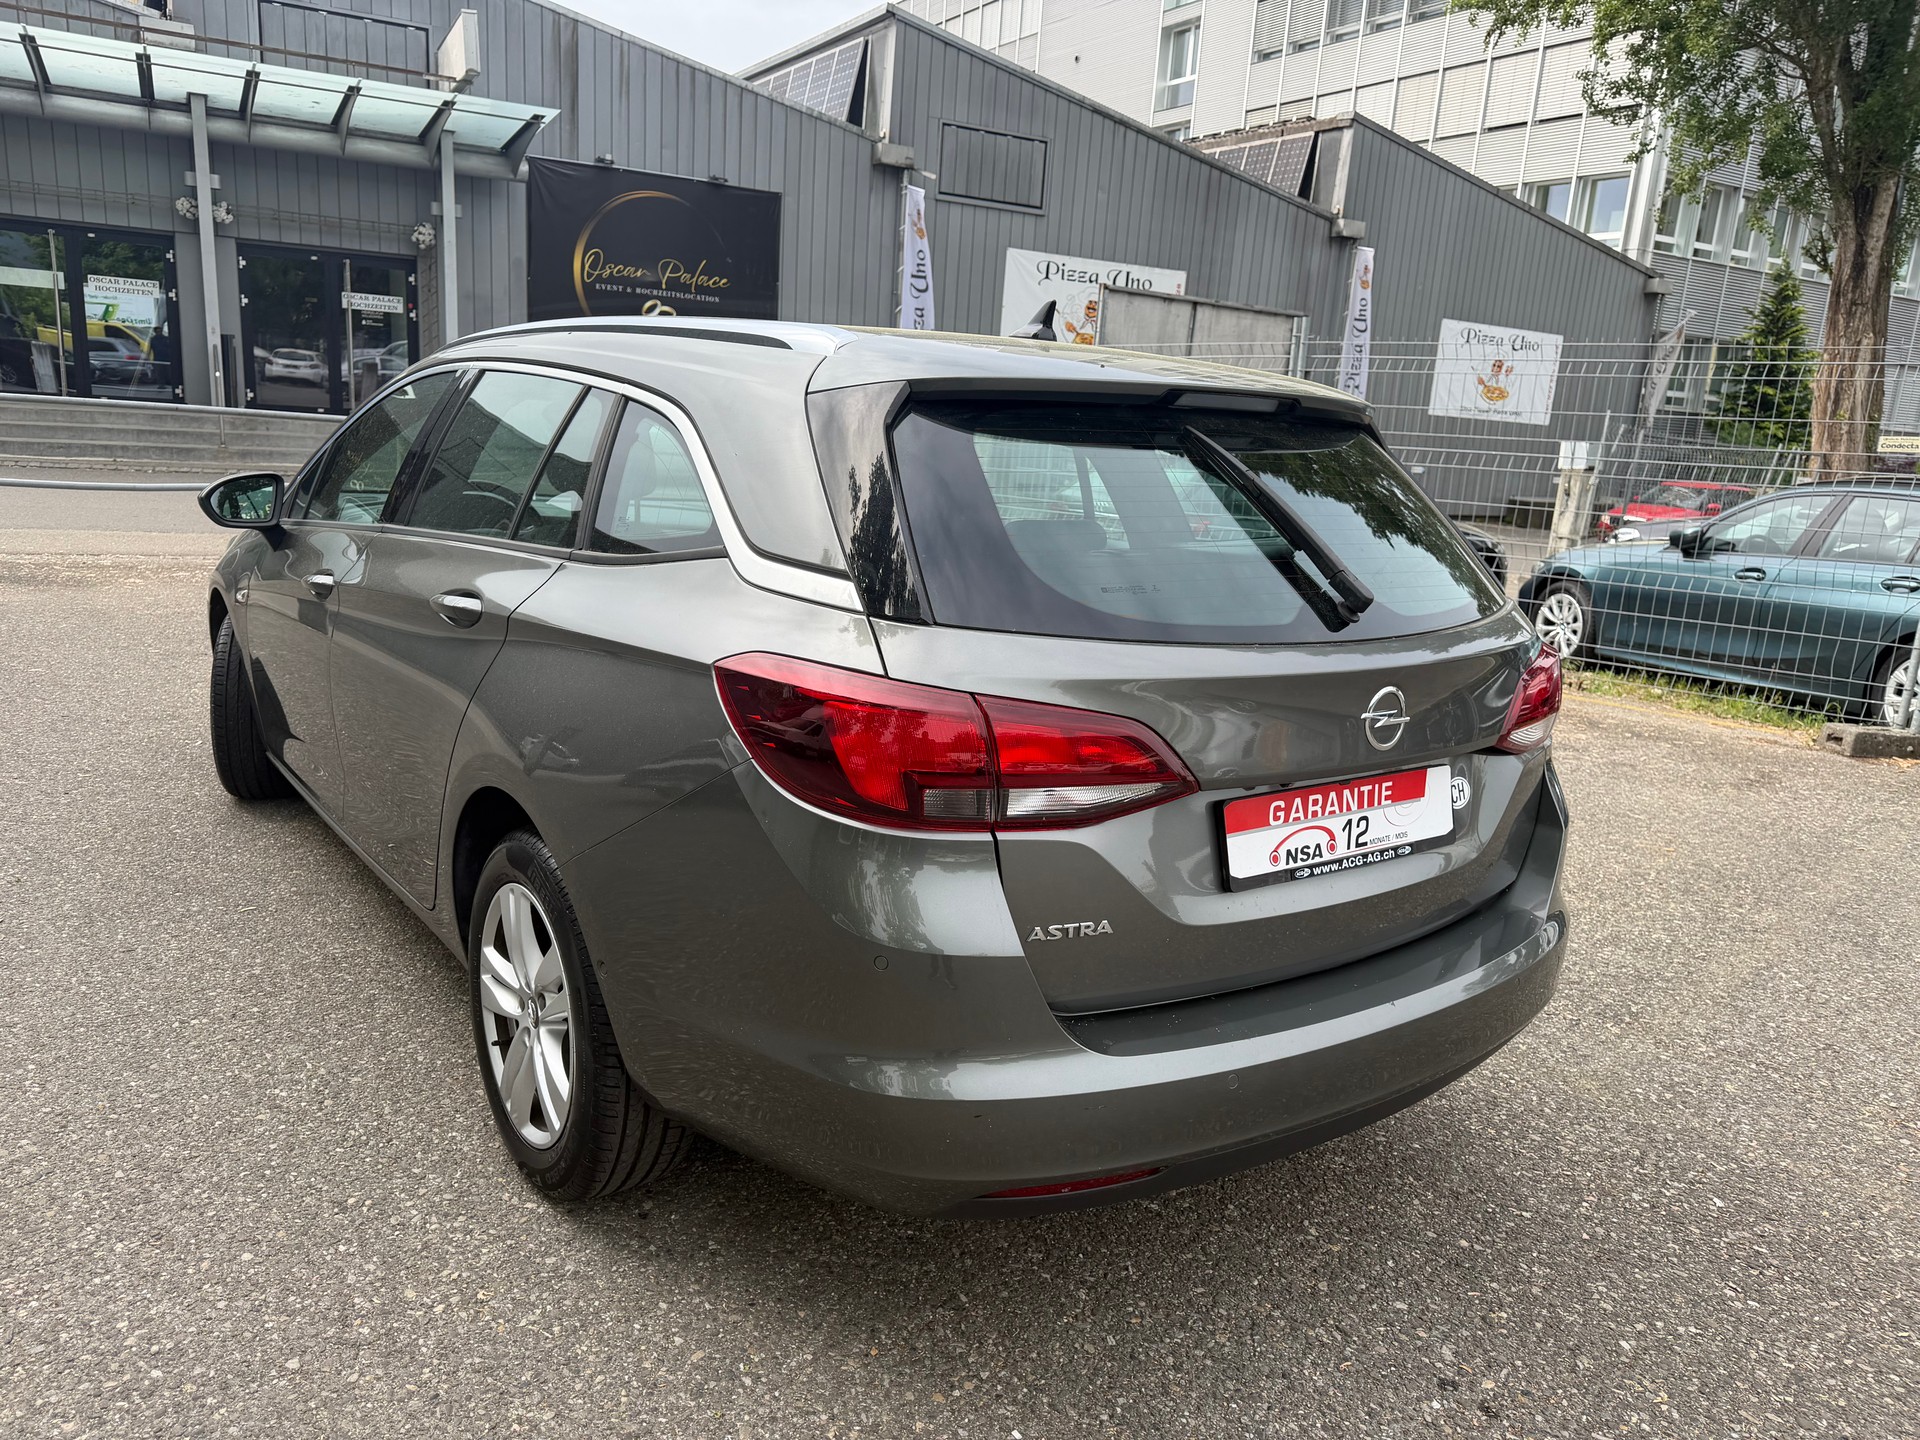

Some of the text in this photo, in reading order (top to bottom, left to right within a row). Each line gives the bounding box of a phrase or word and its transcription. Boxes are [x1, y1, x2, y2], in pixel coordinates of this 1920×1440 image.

[89, 276, 158, 289] OSCAR PALACE
[584, 248, 731, 293] Oscar Palace
[910, 249, 929, 299] Uno
[1036, 260, 1100, 286] Pizza
[1107, 269, 1153, 291] Uno
[94, 285, 154, 296] HOCHZEITEN
[595, 283, 623, 292] EVENT
[635, 287, 720, 303] HOCHZEITSLOCATION
[1352, 297, 1368, 339] Uno
[1460, 327, 1540, 352] Pizza Uno
[1269, 781, 1393, 826] GARANTIE
[1450, 782, 1466, 804] CH
[1341, 815, 1370, 851] 12
[1369, 834, 1391, 845] MONATE
[1395, 831, 1408, 840] MOIS
[1285, 843, 1324, 866] NSA
[1313, 849, 1395, 876] www.ACG-AG.ch
[1026, 920, 1114, 942] ASTRA
